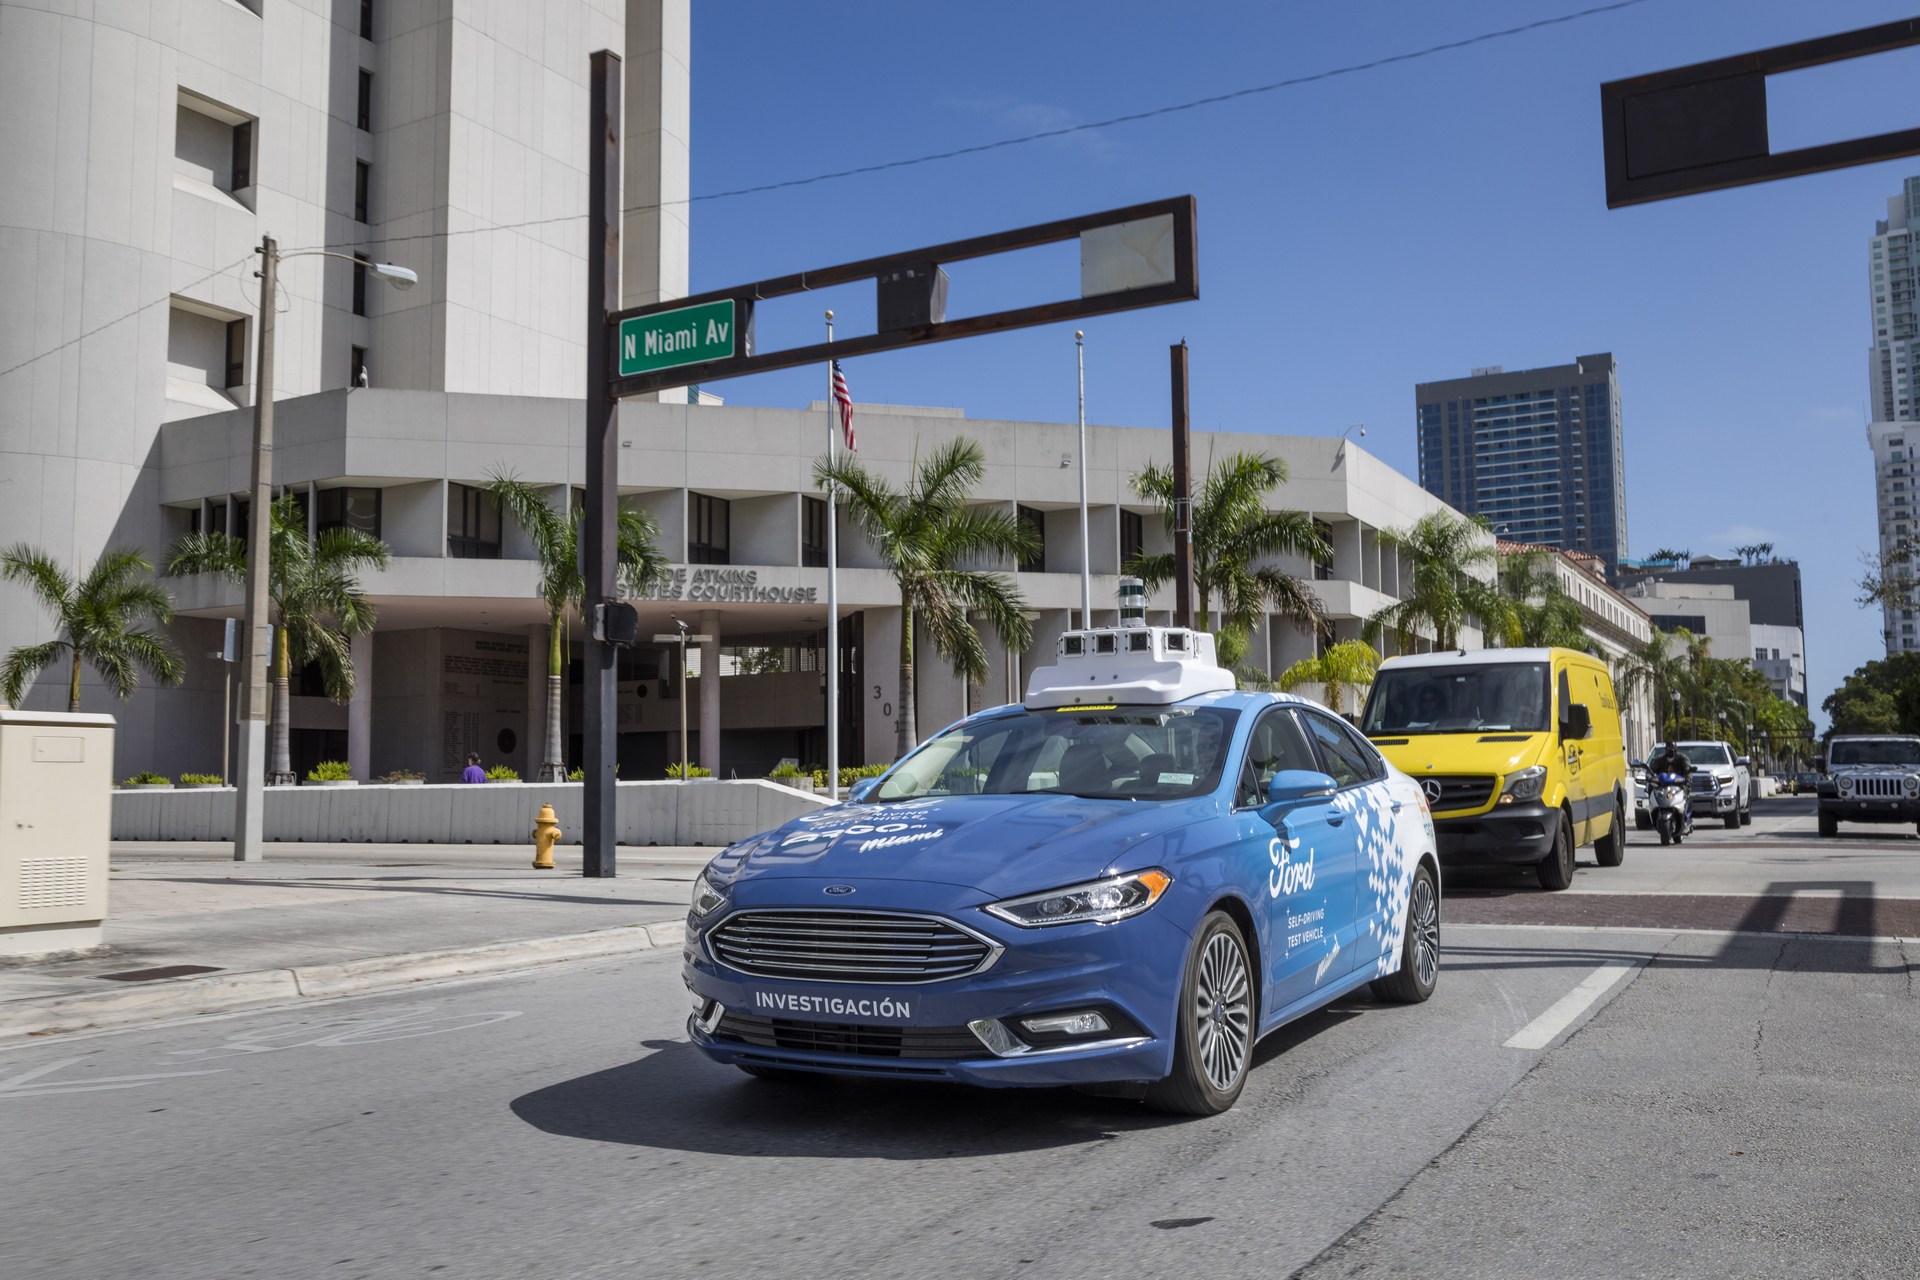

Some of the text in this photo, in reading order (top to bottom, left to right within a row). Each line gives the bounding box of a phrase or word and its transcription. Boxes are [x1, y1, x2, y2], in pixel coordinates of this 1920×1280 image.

[624, 318, 730, 360] N Miami Av
[692, 569, 758, 584] ATKINS
[690, 585, 817, 601] COURTHOUSE
[1269, 837, 1316, 898] Ford
[1288, 908, 1325, 929] SELF-DRIVING
[1288, 926, 1324, 948] TEST VEHICLE
[756, 991, 911, 1019] INVESTIGACIÓN
